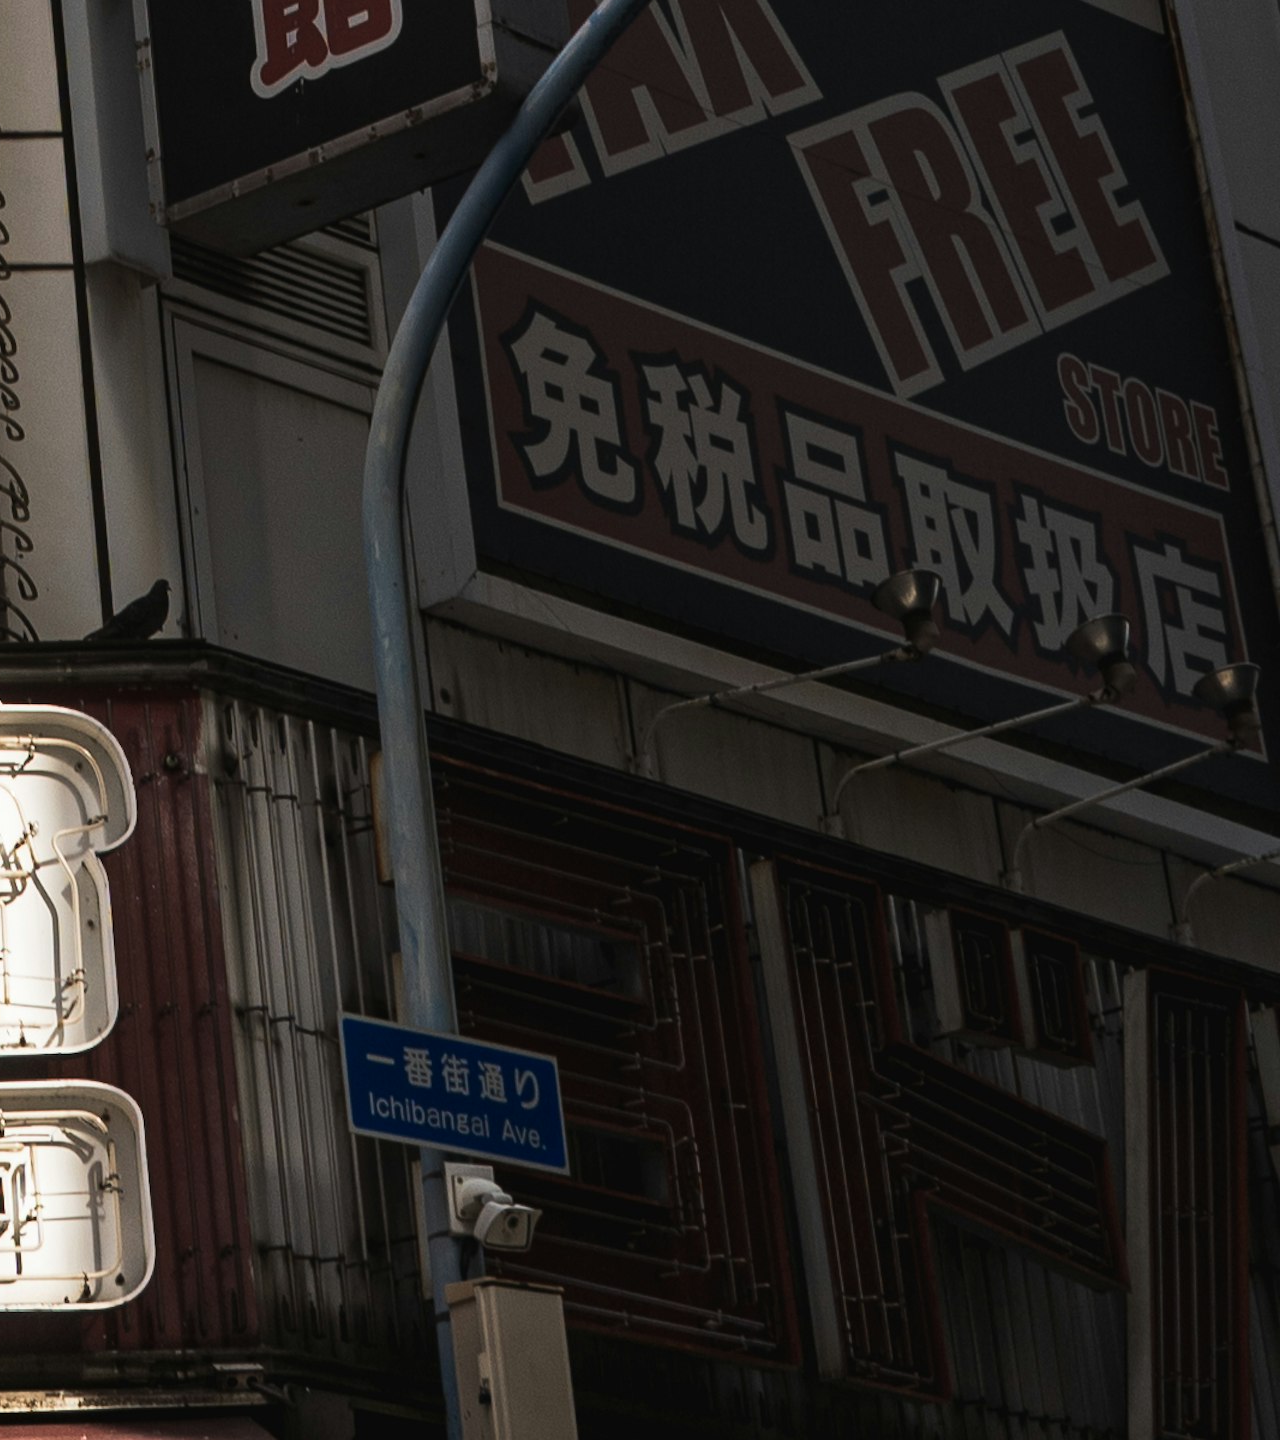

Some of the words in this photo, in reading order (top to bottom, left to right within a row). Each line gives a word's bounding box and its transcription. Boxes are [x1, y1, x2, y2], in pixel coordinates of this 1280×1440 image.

[785, 28, 1173, 402] FREE
[1056, 351, 1231, 493] STORE
[508, 300, 1232, 708] 免税品取扱店
[365, 1045, 541, 1111] 一番街通り
[368, 1090, 491, 1139] Ichibangai
[501, 1117, 548, 1151] Ave.
